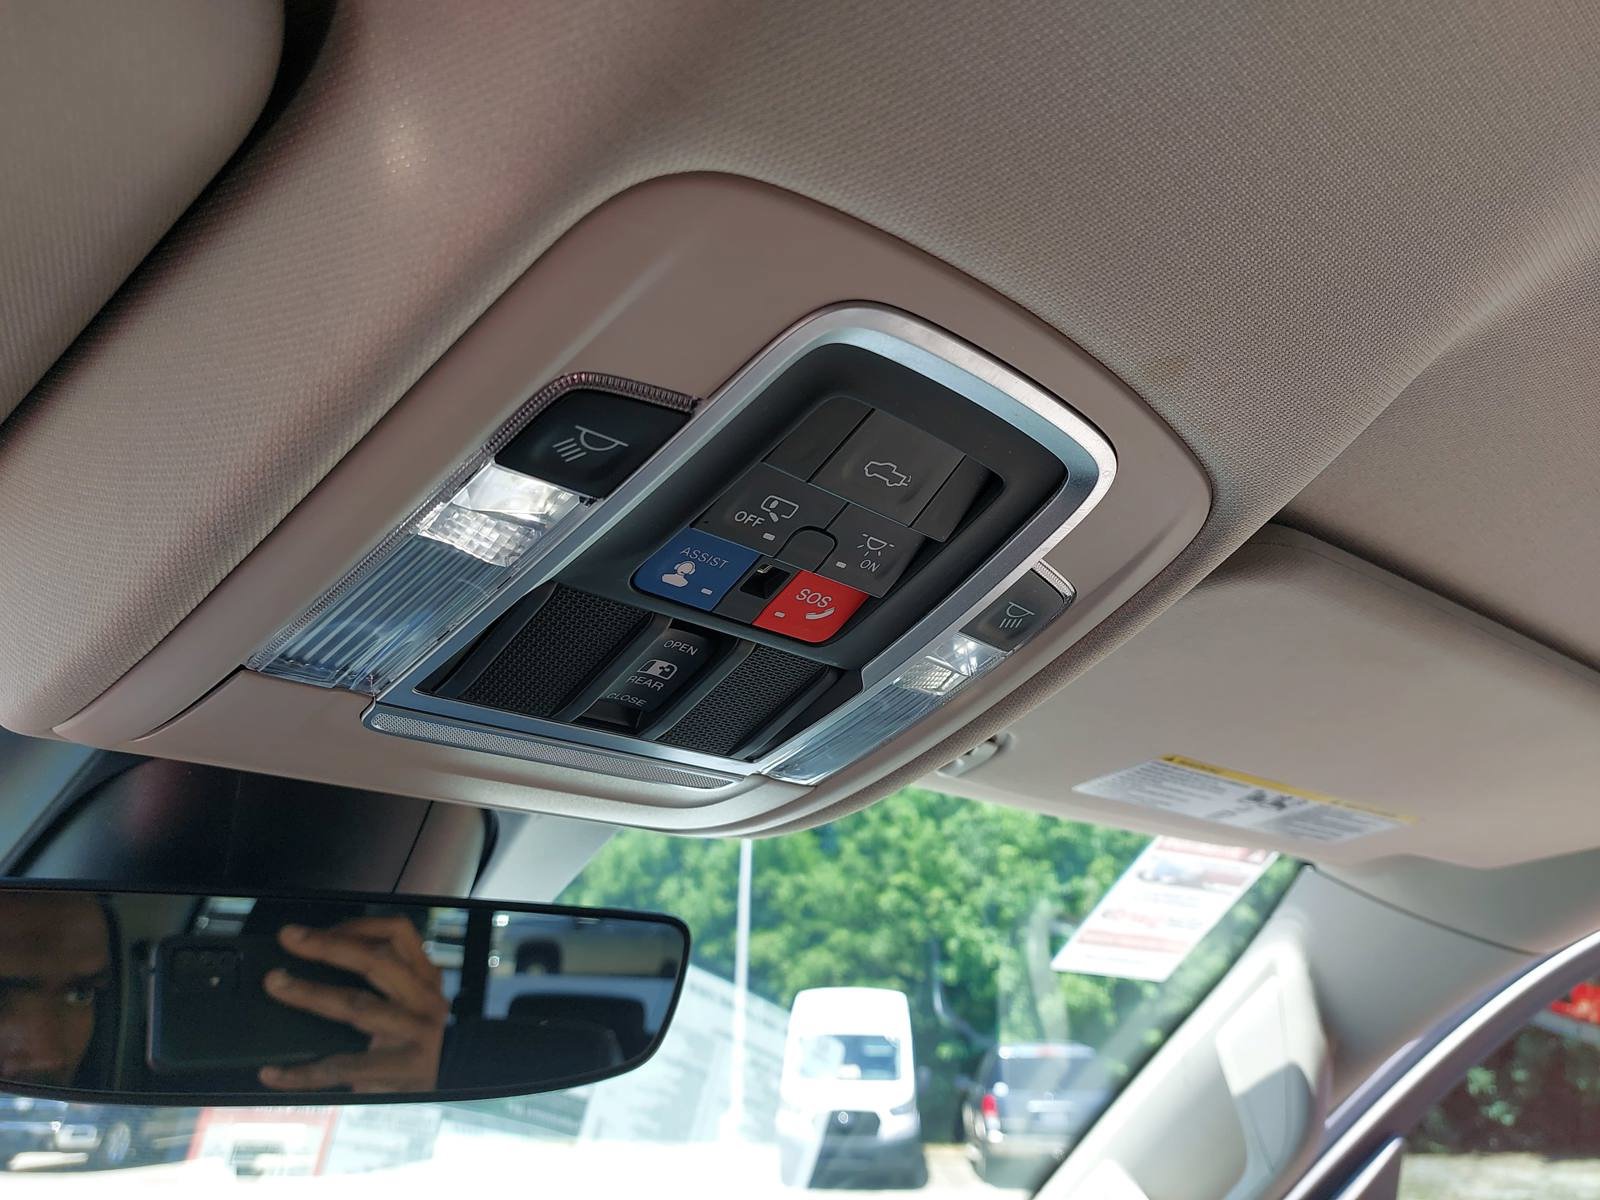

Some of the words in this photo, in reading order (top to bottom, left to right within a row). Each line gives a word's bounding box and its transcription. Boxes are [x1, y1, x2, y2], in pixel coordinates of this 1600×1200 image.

[734, 511, 765, 527] OFF
[680, 547, 729, 569] ASSIST
[860, 559, 880, 573] ON
[796, 588, 832, 608] SOS
[663, 640, 698, 656] OPEN
[625, 675, 664, 691] REAR
[606, 692, 647, 707] CLOSE
